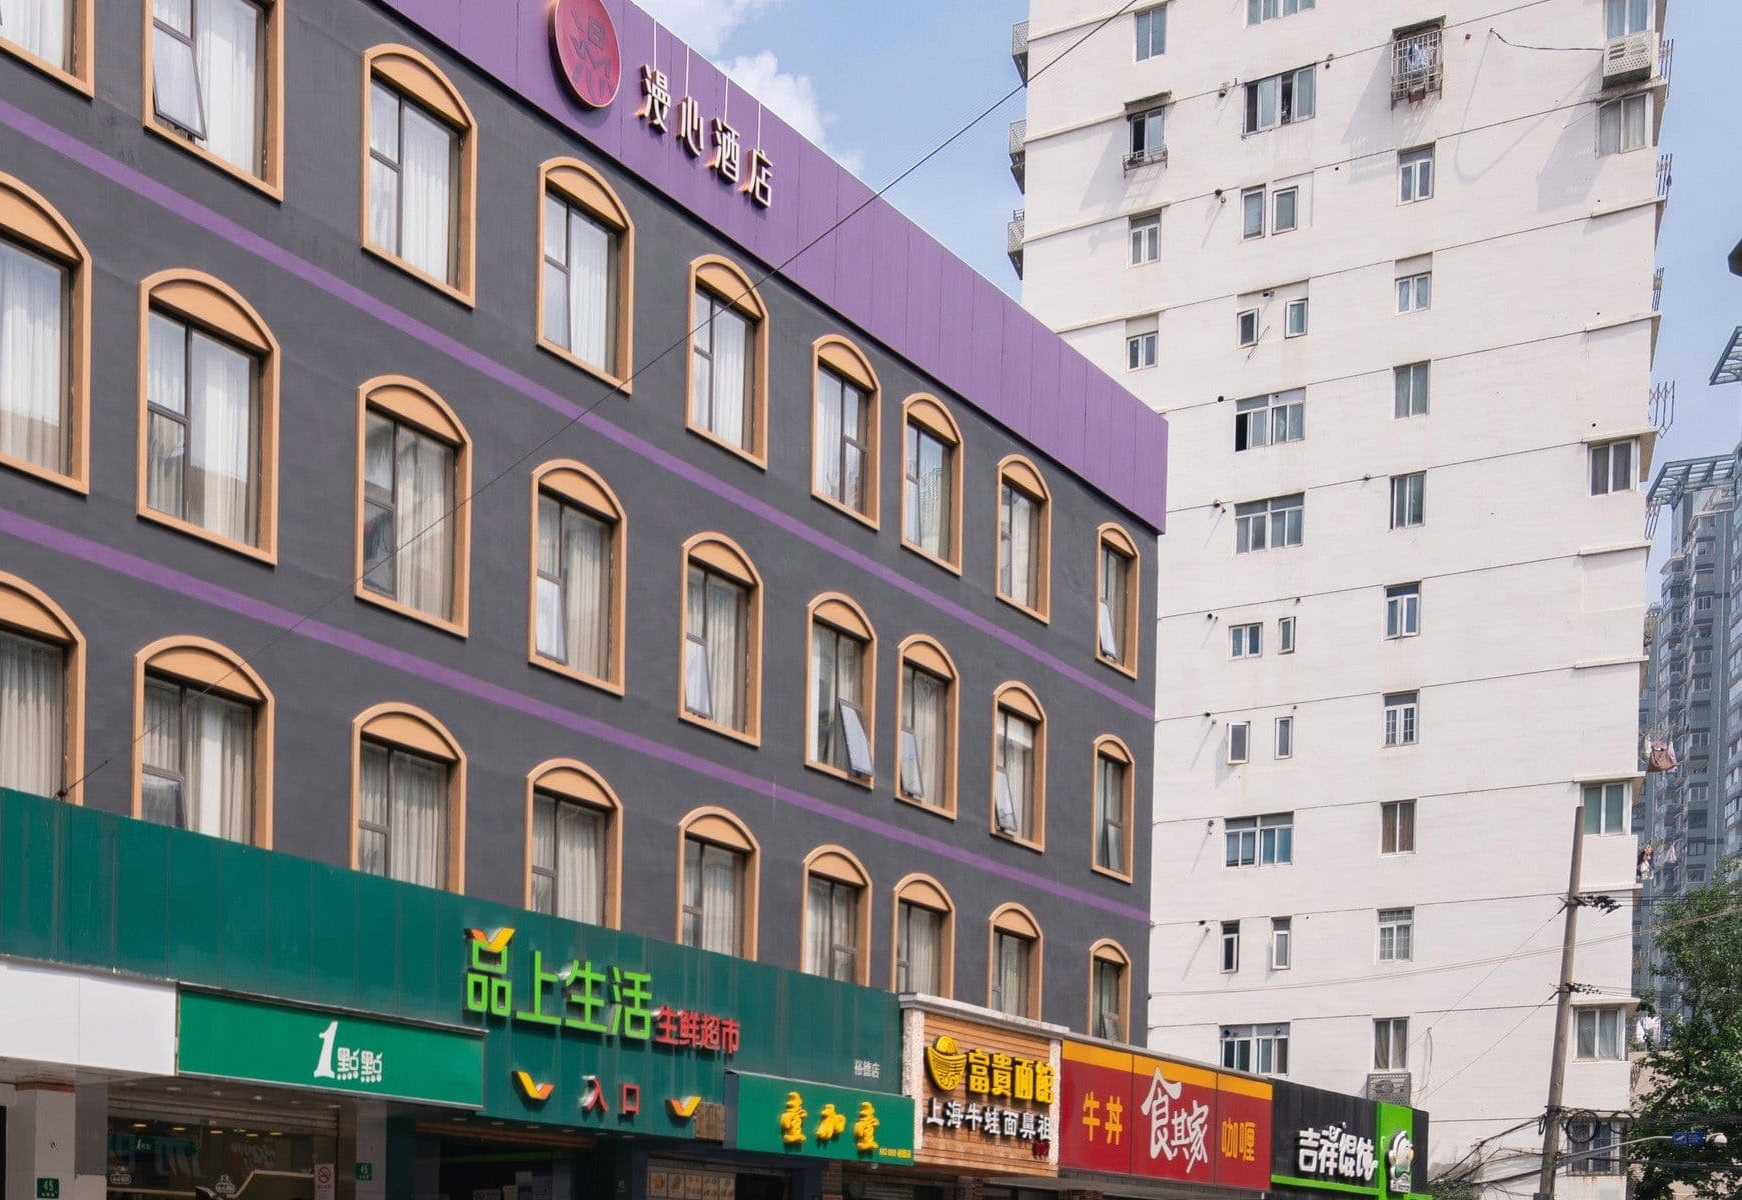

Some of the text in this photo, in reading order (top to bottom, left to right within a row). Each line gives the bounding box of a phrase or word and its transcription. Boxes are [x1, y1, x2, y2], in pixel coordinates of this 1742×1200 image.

[636, 63, 773, 208] 漫心酒店
[467, 930, 653, 1040] 品上生活
[579, 1074, 640, 1116] 入口
[1082, 1091, 1123, 1145] 牛丼
[1141, 1067, 1209, 1173] 食其家
[1221, 1117, 1256, 1162] 咖喱
